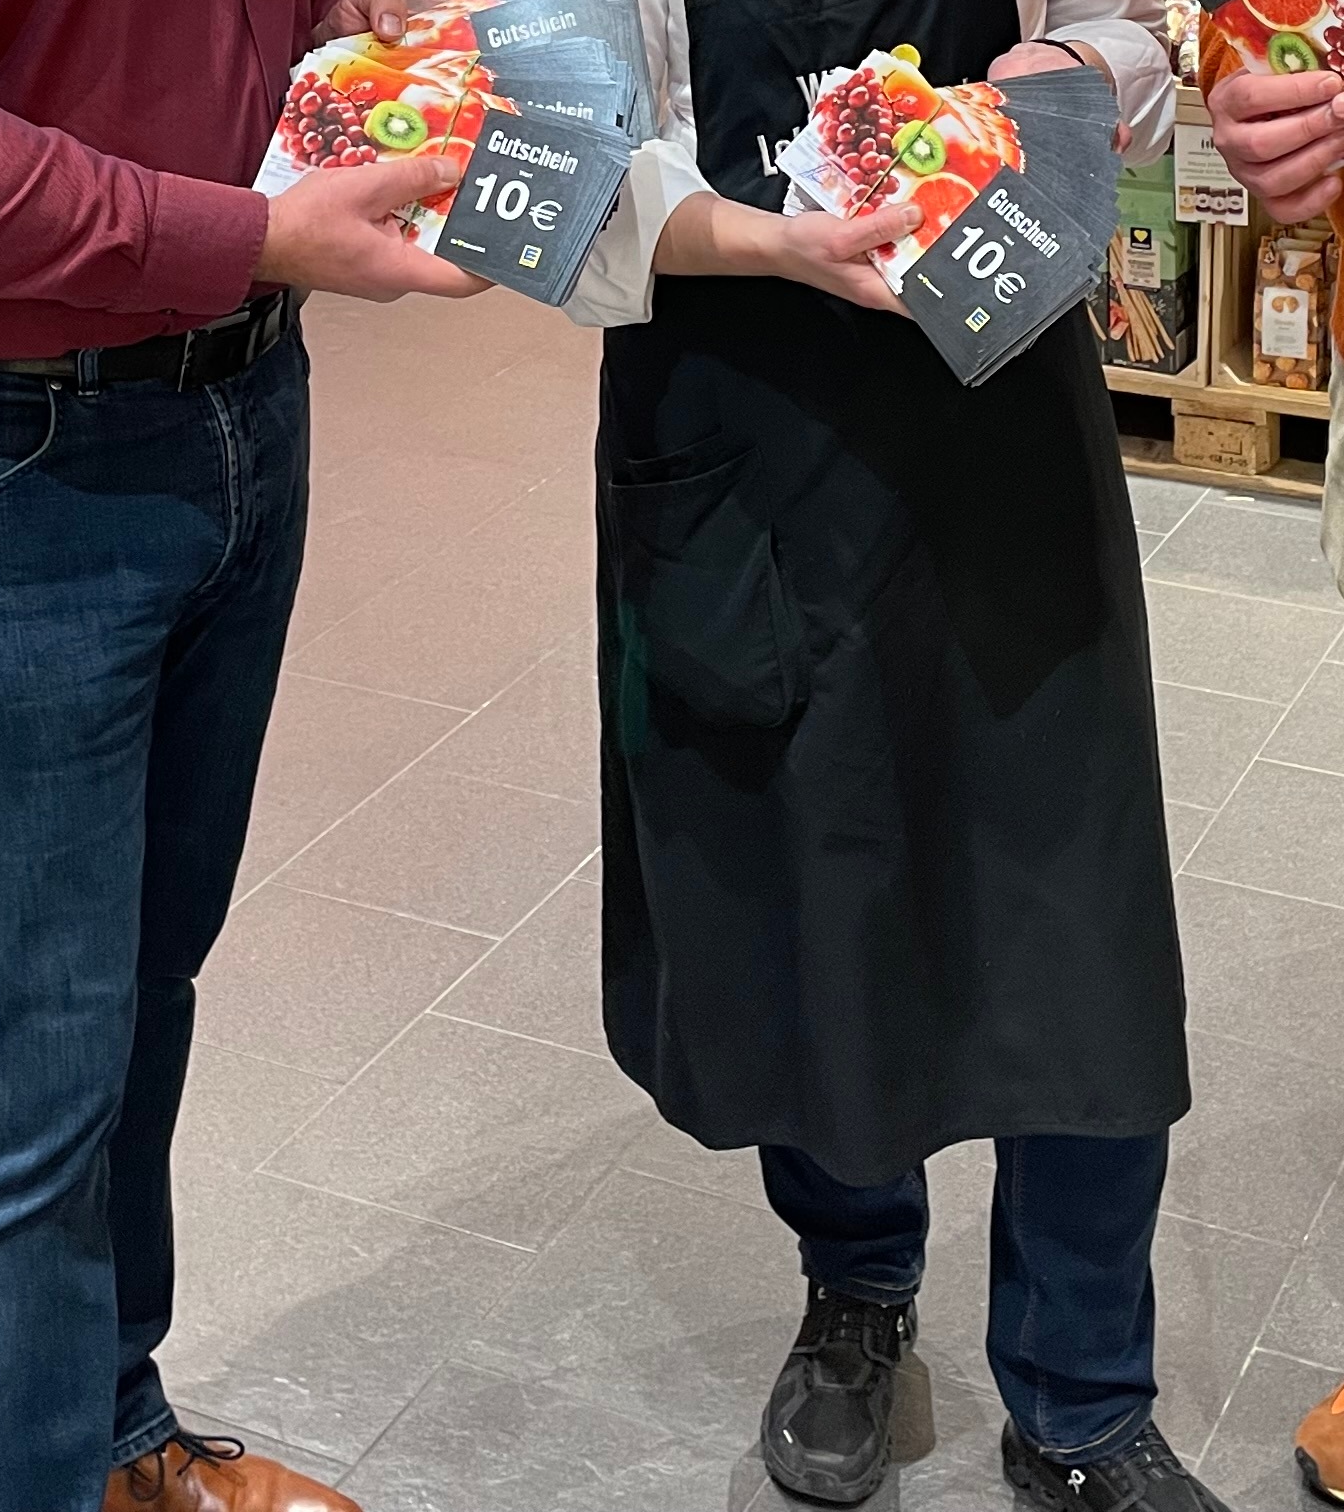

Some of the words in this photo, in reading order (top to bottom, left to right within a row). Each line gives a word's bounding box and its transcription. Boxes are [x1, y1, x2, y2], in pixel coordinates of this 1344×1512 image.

[487, 11, 577, 49] Gutschein
[487, 129, 579, 175] Gutschein
[987, 188, 1061, 259] Gutschein
